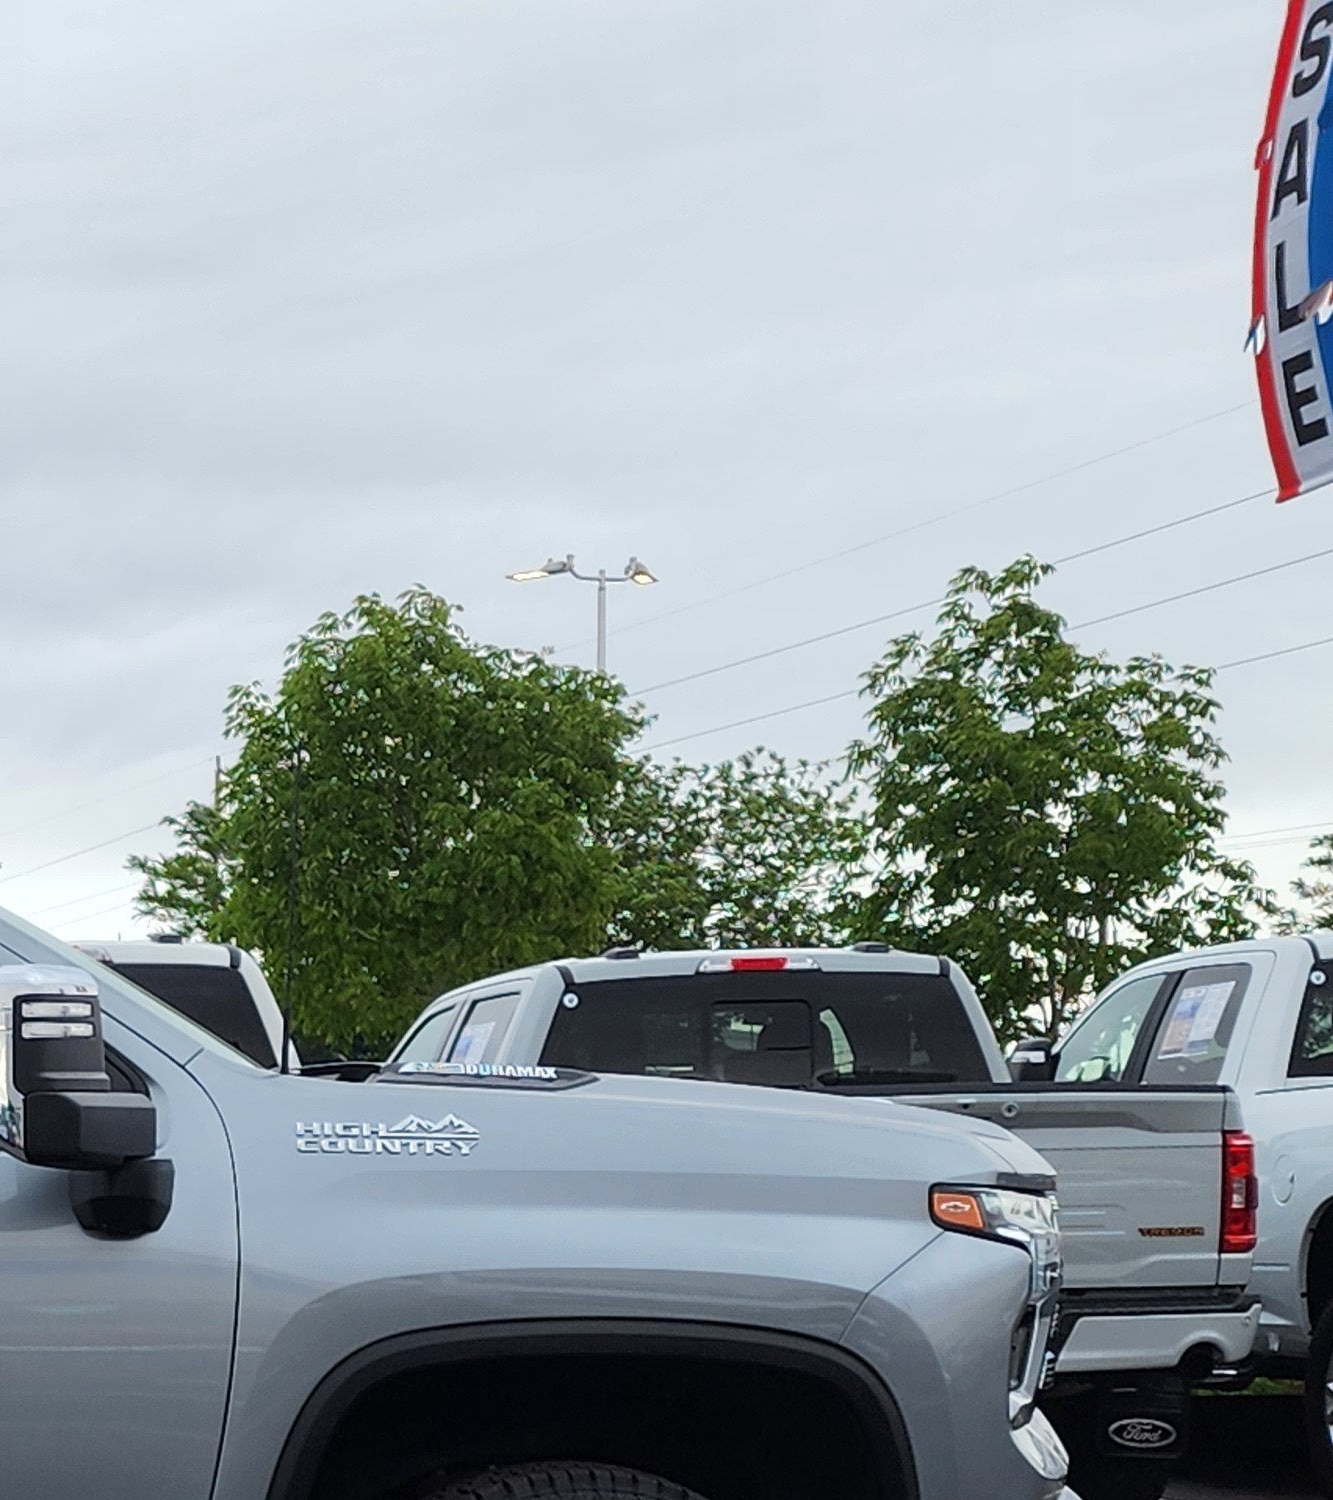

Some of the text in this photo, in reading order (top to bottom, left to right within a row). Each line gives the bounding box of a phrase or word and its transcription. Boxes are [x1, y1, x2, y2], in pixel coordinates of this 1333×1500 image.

[1271, 1, 1333, 447] SALE
[465, 1063, 558, 1080] DURAMAX
[295, 1121, 387, 1139] HIGH
[295, 1138, 480, 1157] COUNTRY
